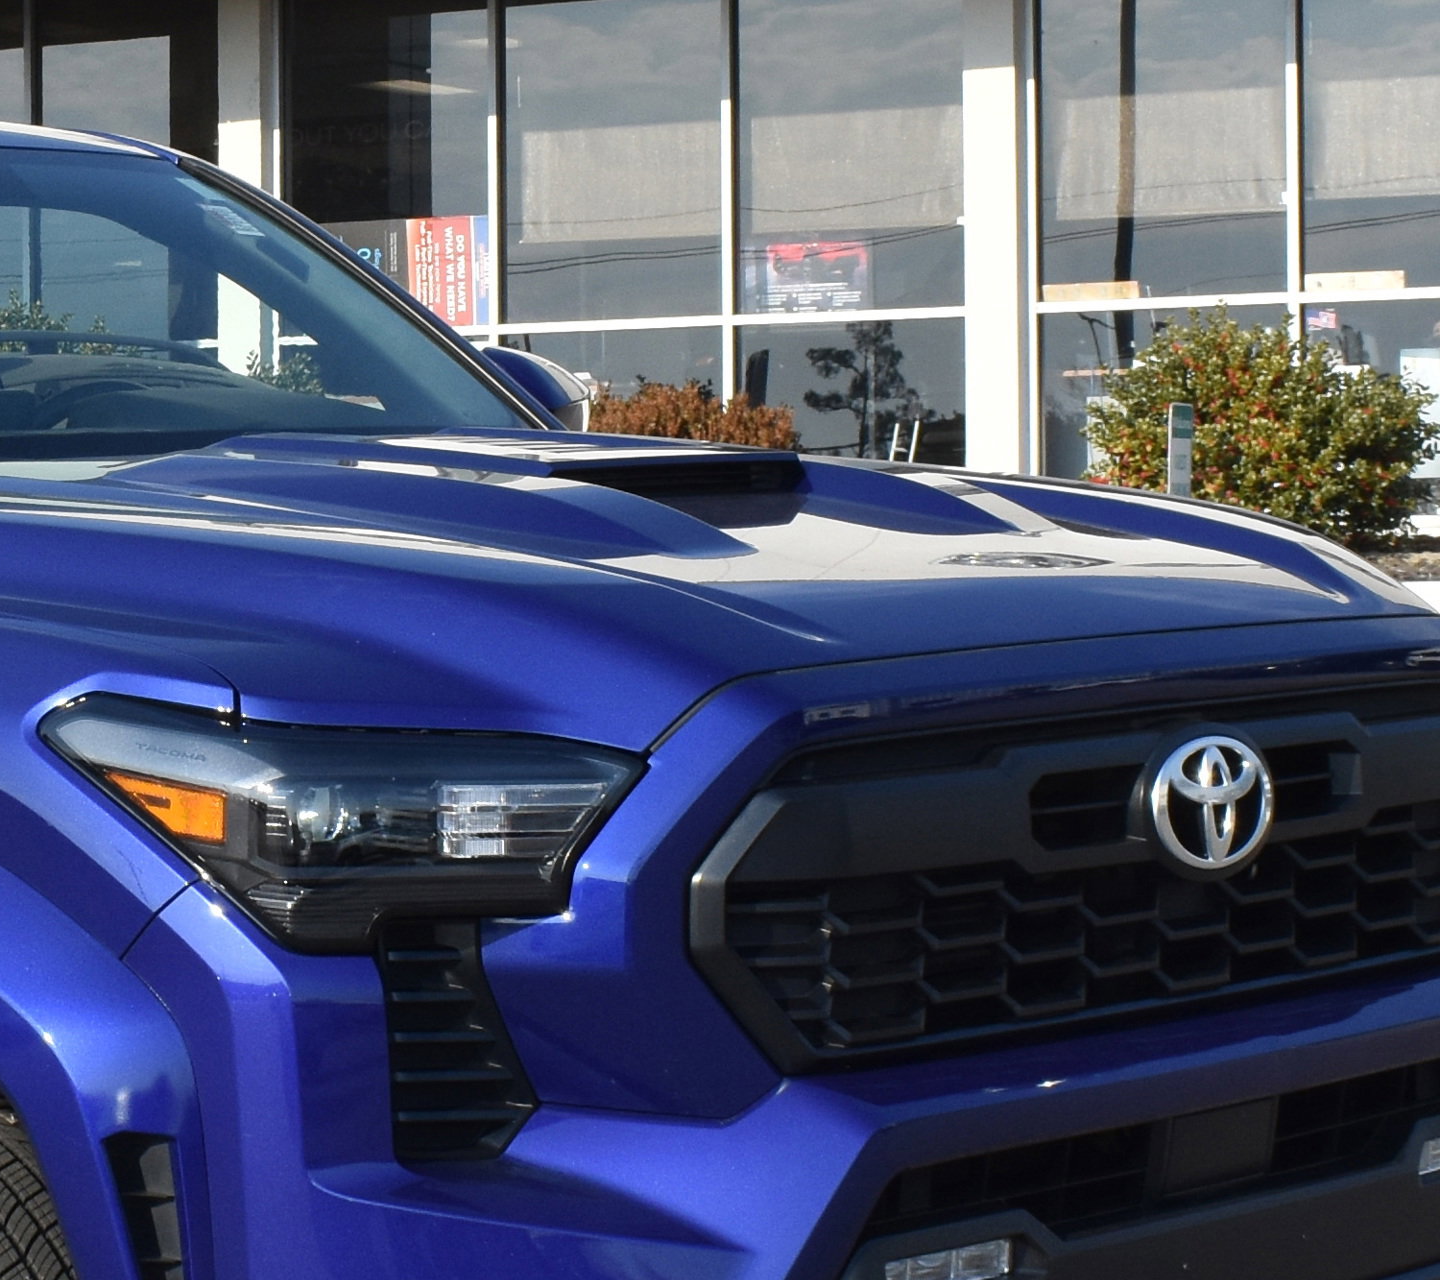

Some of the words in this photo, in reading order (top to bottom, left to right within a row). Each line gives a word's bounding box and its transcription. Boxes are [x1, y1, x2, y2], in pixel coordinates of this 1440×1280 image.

[444, 227, 454, 261] WHAT
[455, 234, 465, 253] DO
[445, 263, 455, 283] WE
[457, 255, 466, 279] YOU
[446, 285, 456, 322] NEED?
[457, 281, 467, 312] HAVE
[135, 742, 207, 762] TACOMA
